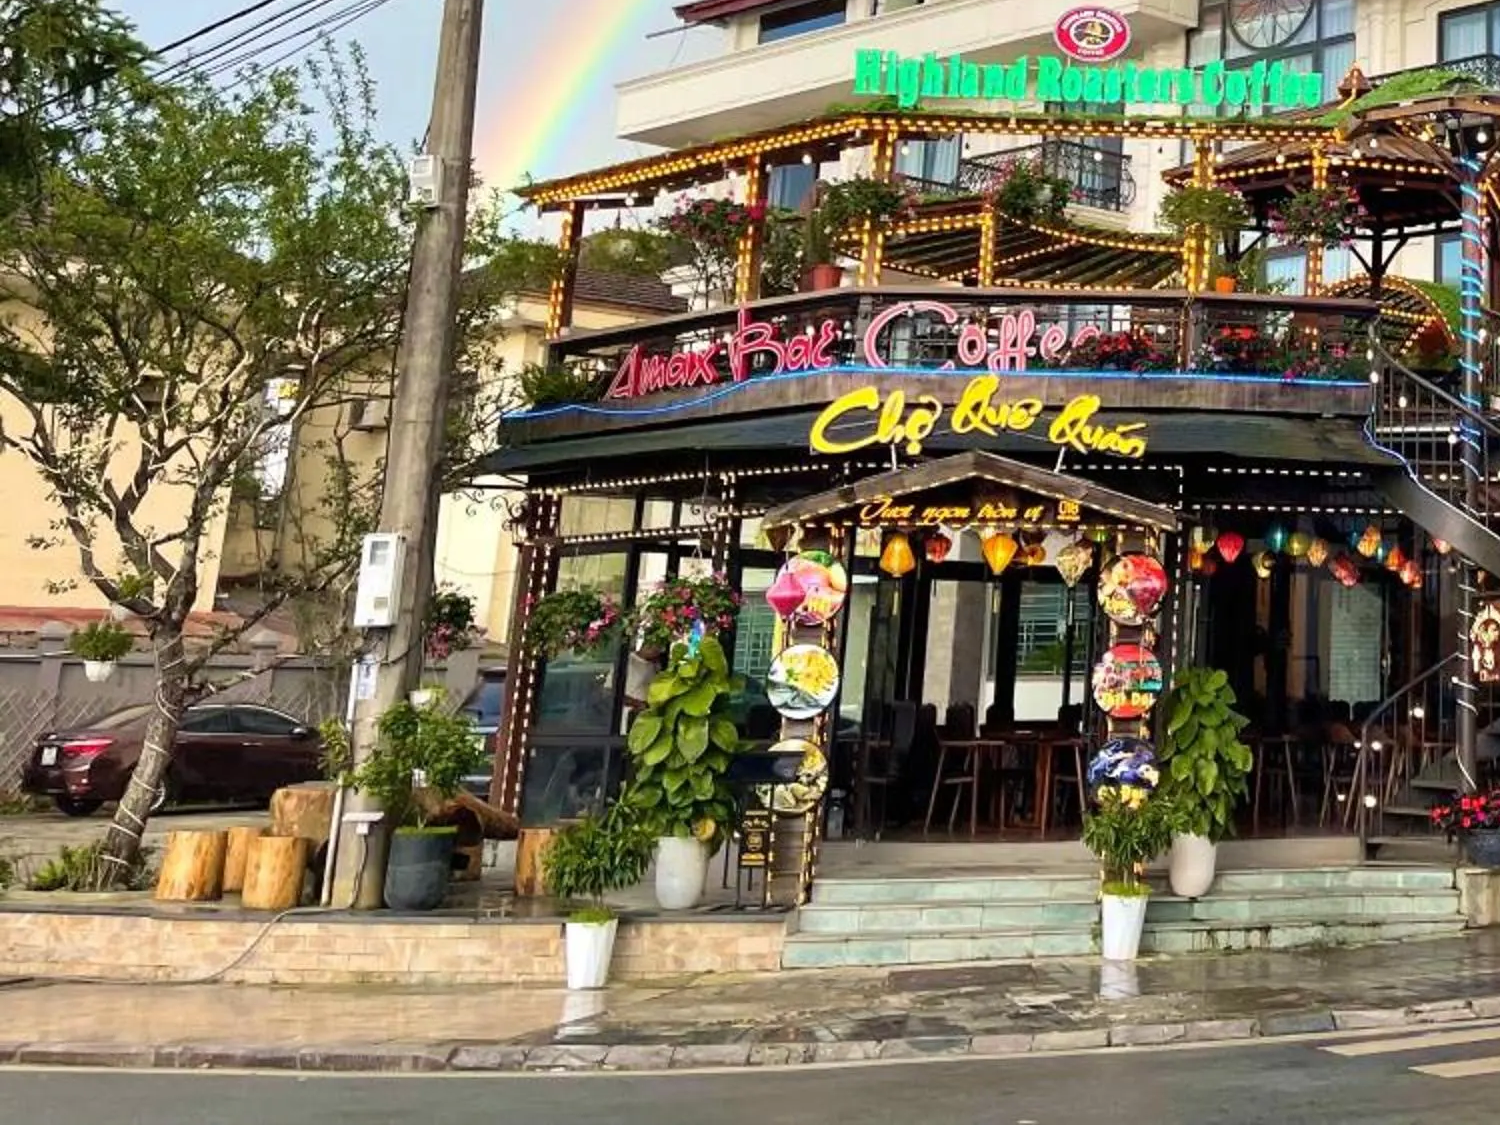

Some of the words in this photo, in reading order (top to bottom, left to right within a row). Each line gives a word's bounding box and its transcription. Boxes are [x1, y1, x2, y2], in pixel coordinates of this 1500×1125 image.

[853, 49, 1027, 109] Highland
[1034, 53, 1195, 105] Roasters
[1202, 58, 1324, 108] Coffee
[809, 385, 942, 455] Chợ
[951, 374, 1043, 437] Quê
[1048, 394, 1147, 459] Quán
